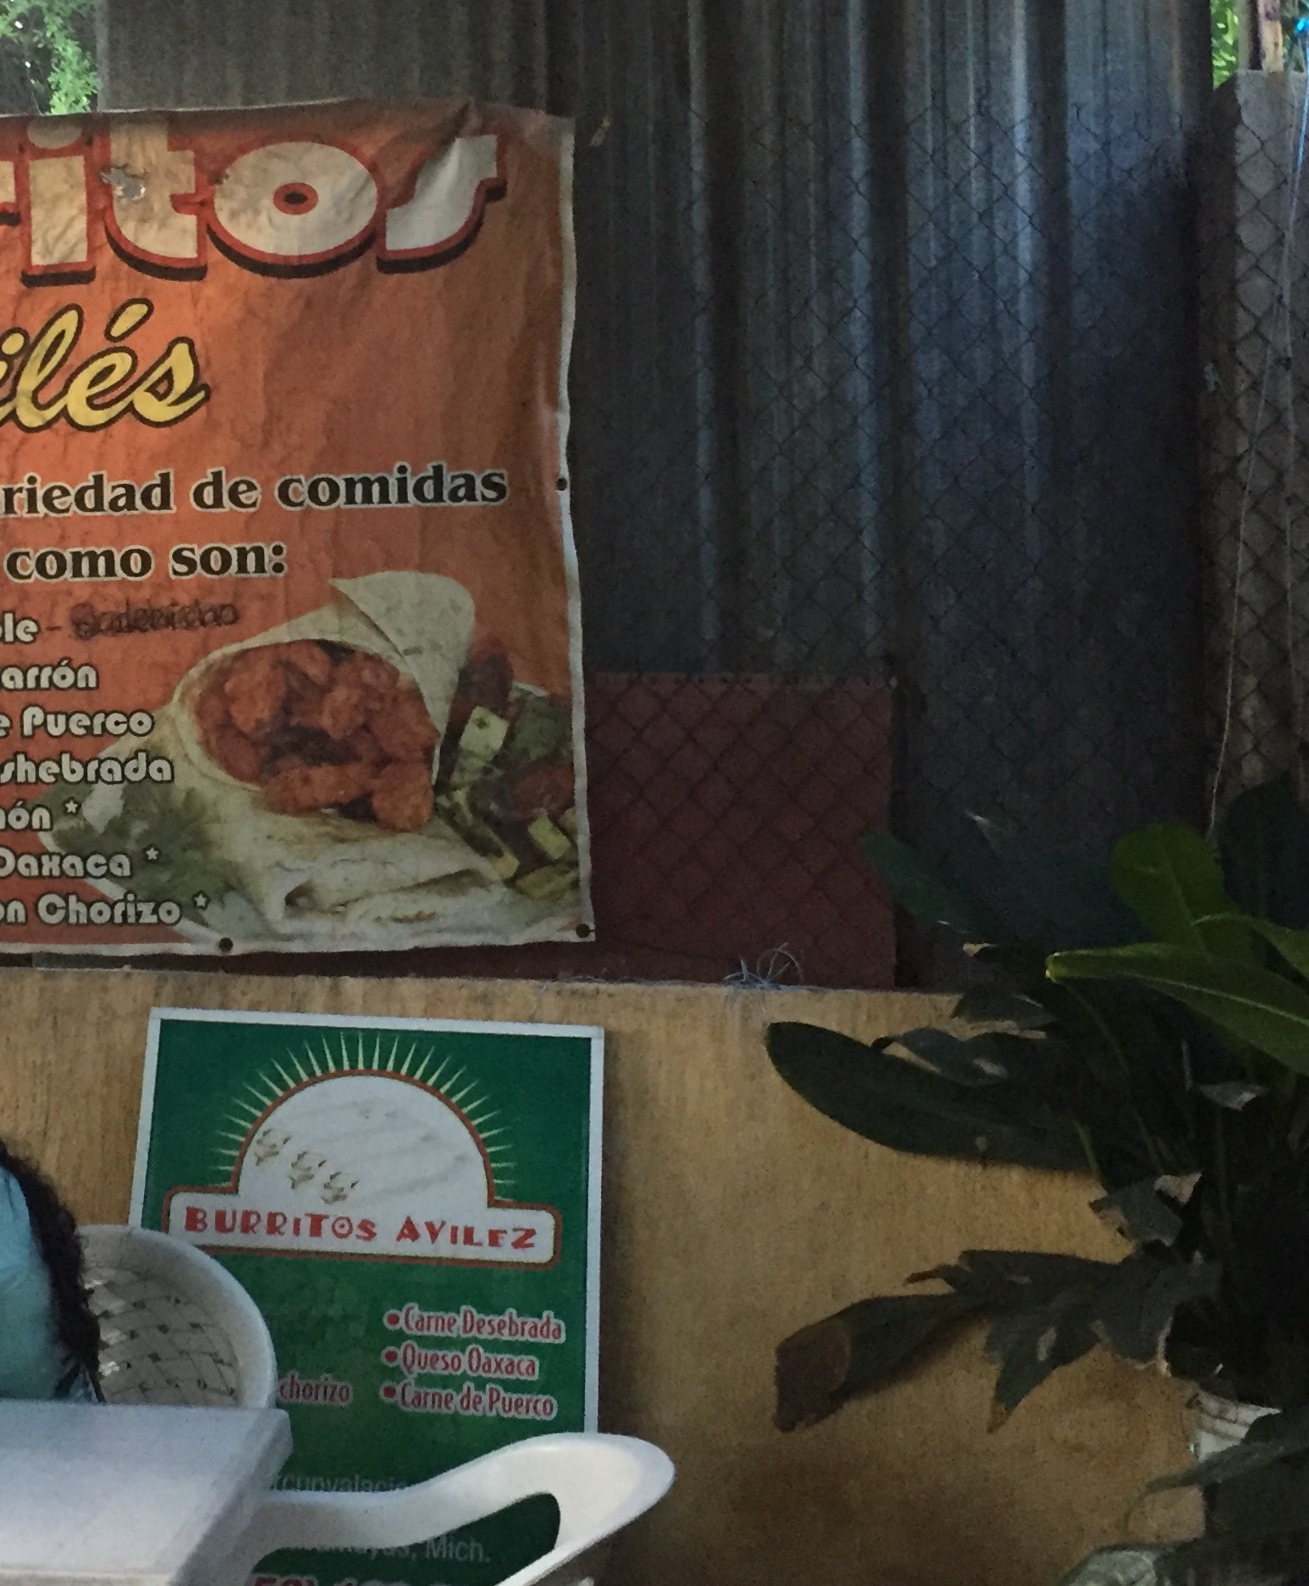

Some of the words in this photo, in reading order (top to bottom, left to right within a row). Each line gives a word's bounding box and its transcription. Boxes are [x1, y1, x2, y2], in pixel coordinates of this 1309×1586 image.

[191, 468, 260, 511] de
[277, 462, 508, 509] comidas
[4, 547, 153, 581] como
[168, 542, 287, 578] son:
[20, 705, 155, 738] Puerco
[36, 893, 182, 926] Chorizo
[404, 1305, 457, 1333] Carne
[461, 1309, 563, 1340] Desebrada
[402, 1343, 462, 1374] Queso
[468, 1347, 537, 1377] Oaxaca
[400, 1382, 454, 1411] Carne
[459, 1385, 483, 1412] de
[488, 1386, 554, 1417] Puerco
